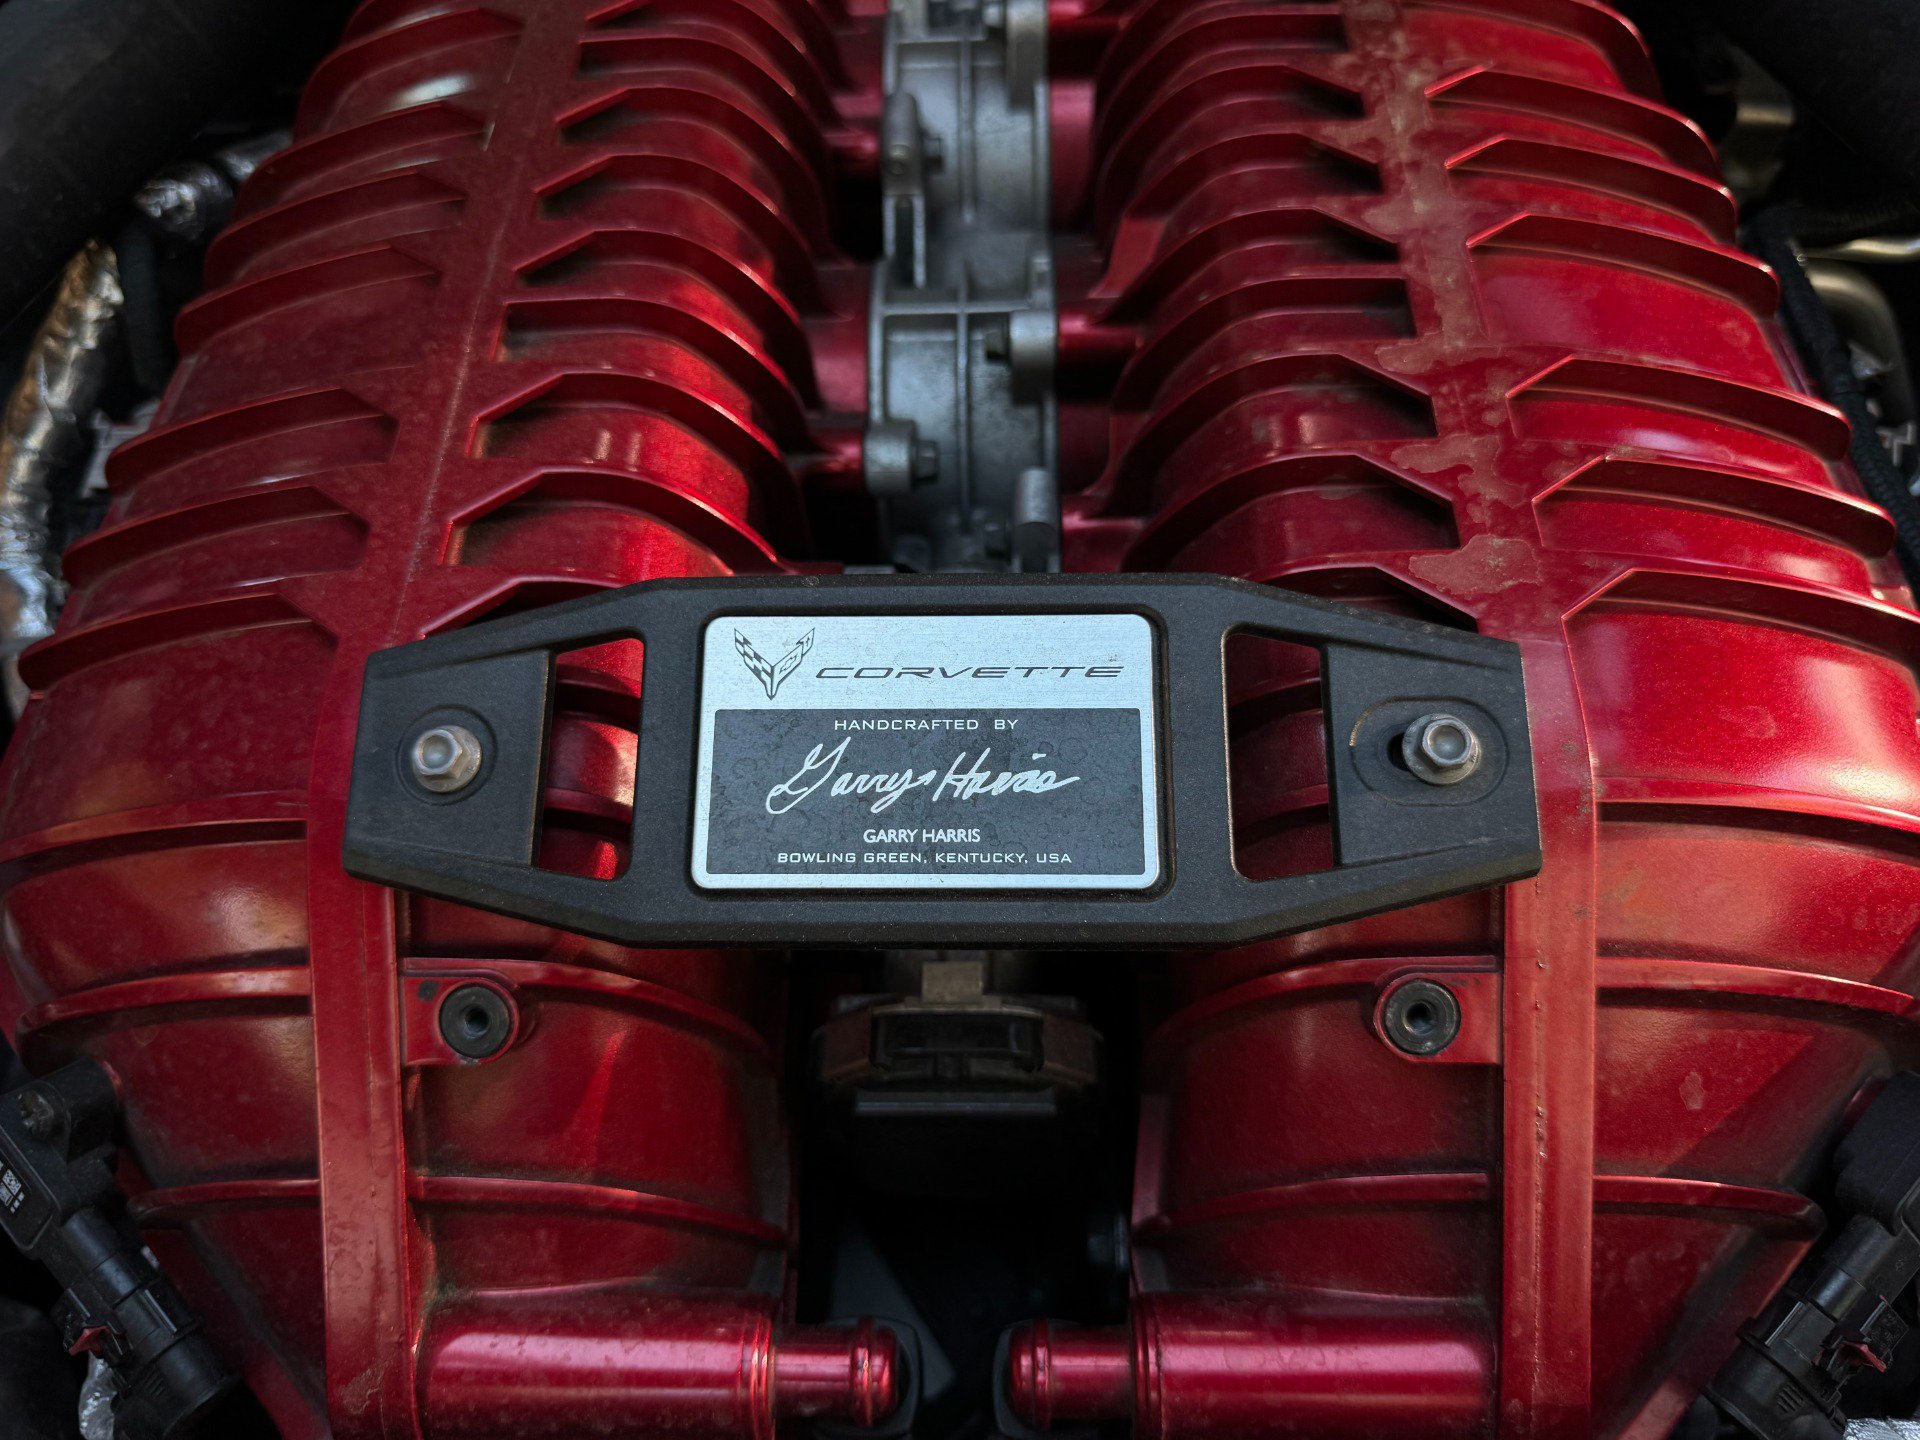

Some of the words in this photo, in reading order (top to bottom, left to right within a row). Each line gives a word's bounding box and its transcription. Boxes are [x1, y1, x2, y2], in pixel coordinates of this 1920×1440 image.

[815, 665, 1125, 679] CORVETTE
[834, 719, 979, 731] HANDCRAFTED
[993, 719, 1019, 731] BY
[863, 828, 919, 844] GARRY
[923, 828, 981, 844] HARRIS
[777, 852, 857, 863] BOWLING
[863, 852, 928, 865] GREEN,
[935, 852, 1029, 865] KENTUCKY,
[1035, 852, 1073, 863] USA
